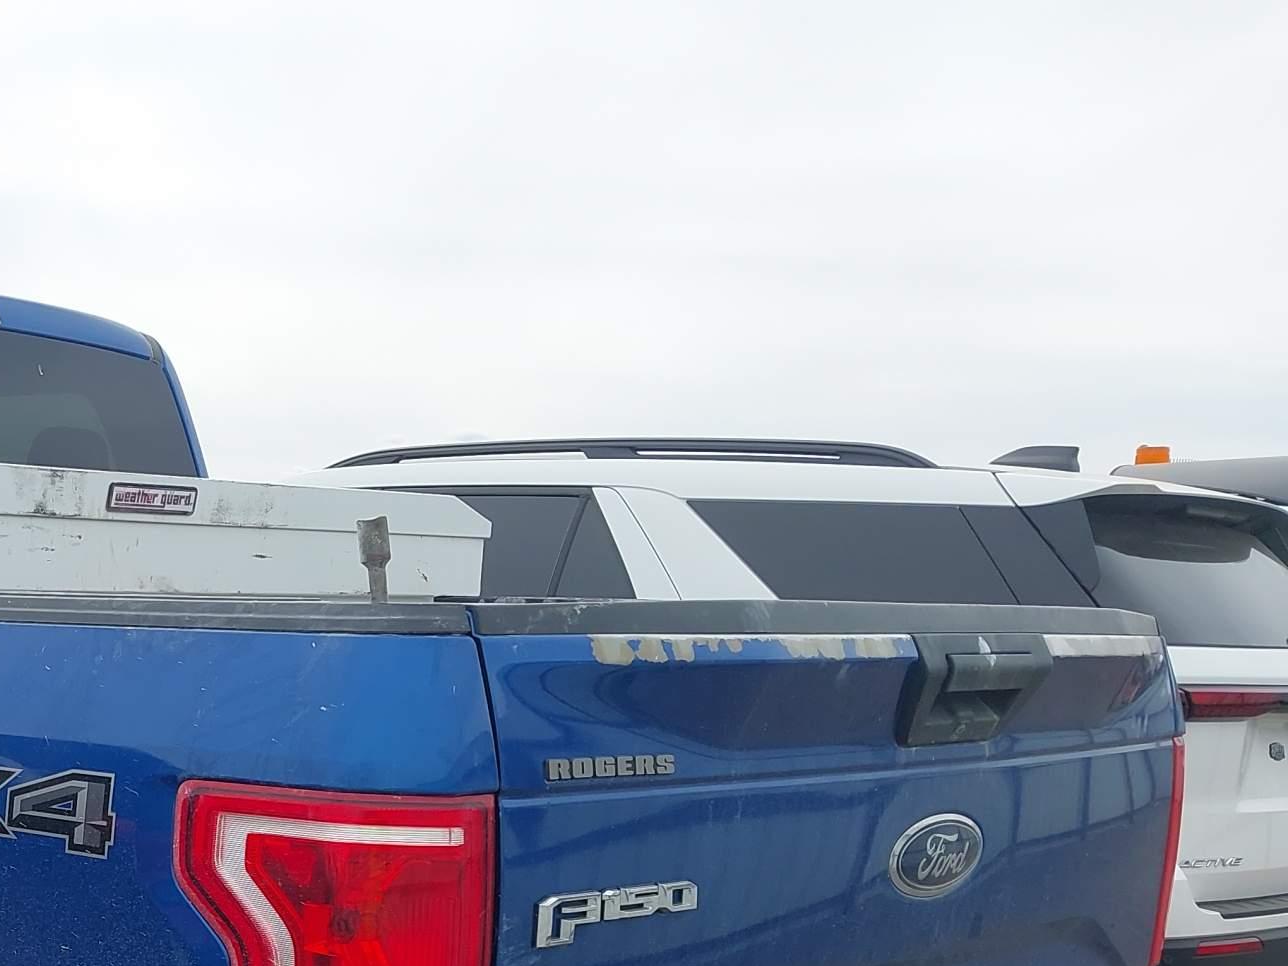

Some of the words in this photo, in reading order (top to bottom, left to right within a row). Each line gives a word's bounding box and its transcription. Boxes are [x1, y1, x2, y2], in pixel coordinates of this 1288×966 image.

[114, 489, 159, 504] weather
[546, 754, 676, 781] ROGERS
[917, 833, 970, 880] Ford
[1179, 857, 1244, 868] ACTIVE
